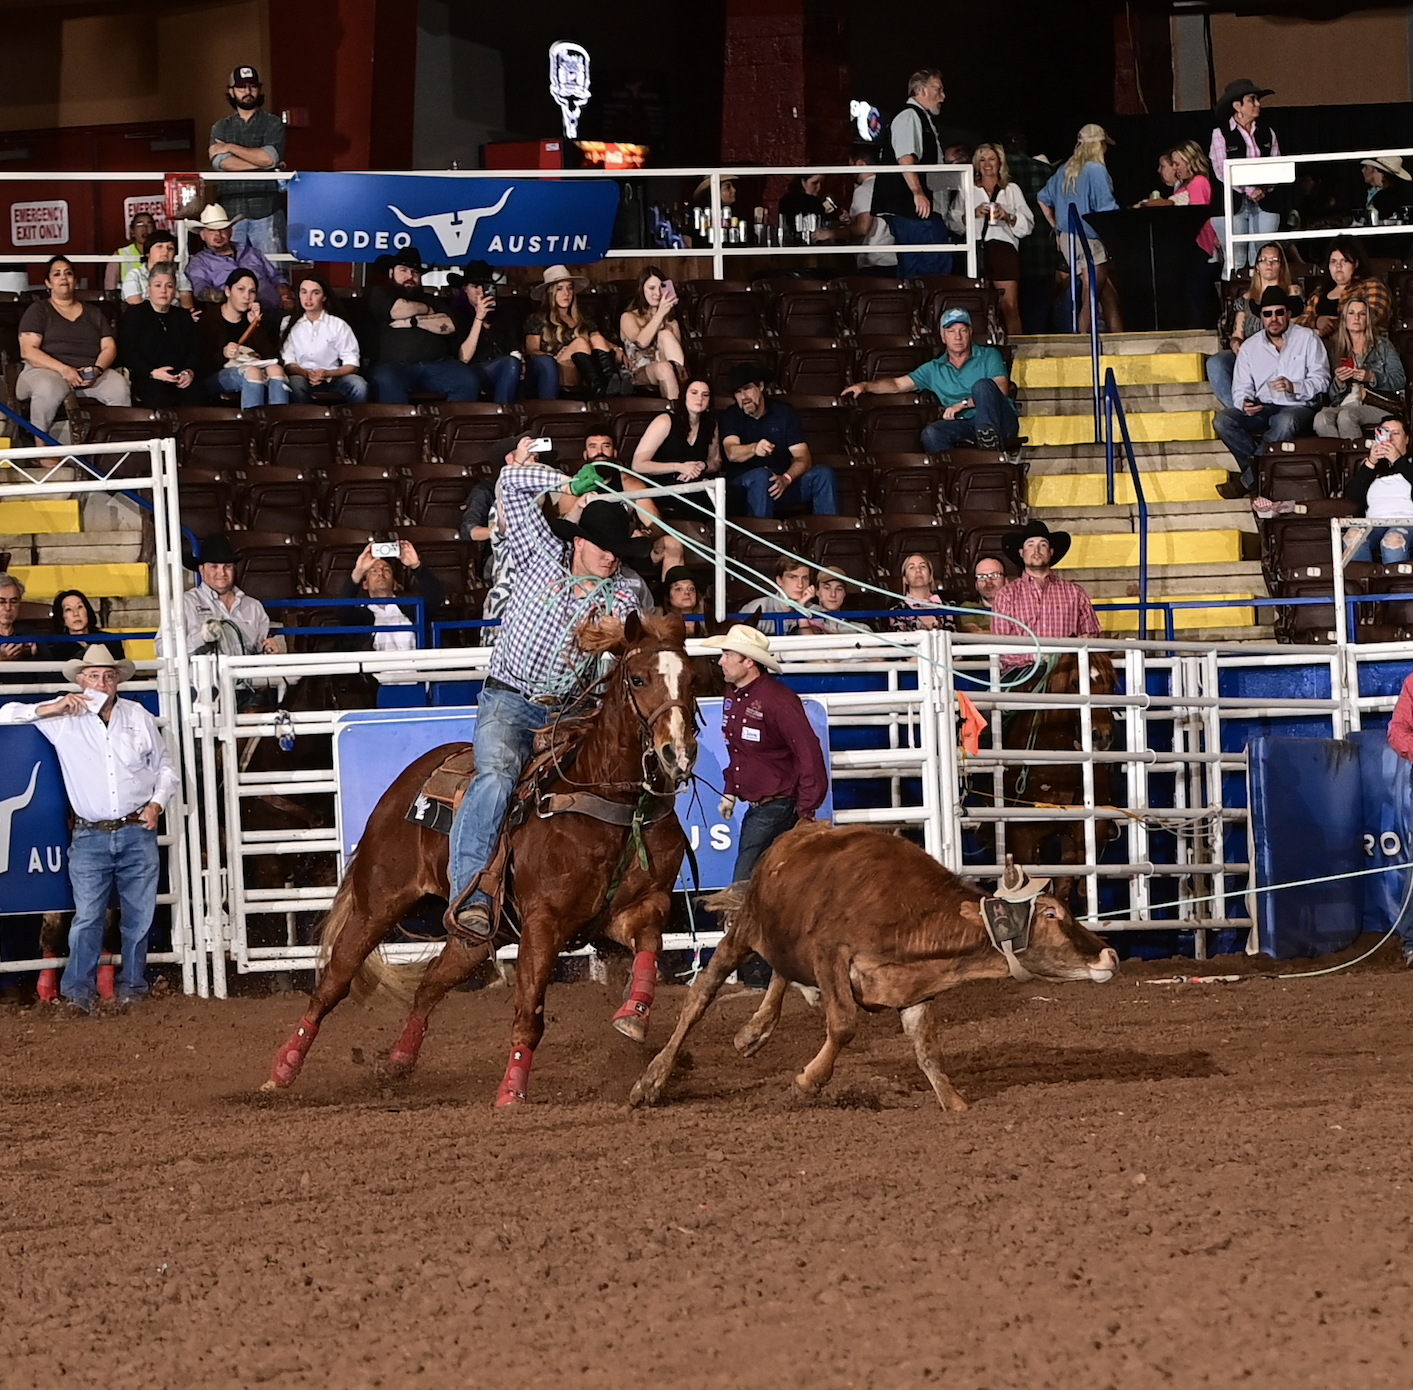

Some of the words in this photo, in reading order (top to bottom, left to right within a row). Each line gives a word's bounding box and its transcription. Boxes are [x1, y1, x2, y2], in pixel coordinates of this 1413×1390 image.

[14, 206, 64, 223] EMERGENCY
[16, 224, 37, 241] EXIT
[39, 223, 64, 240] ONLY
[309, 229, 411, 249] RODEO
[488, 235, 588, 252] AUSTIN
